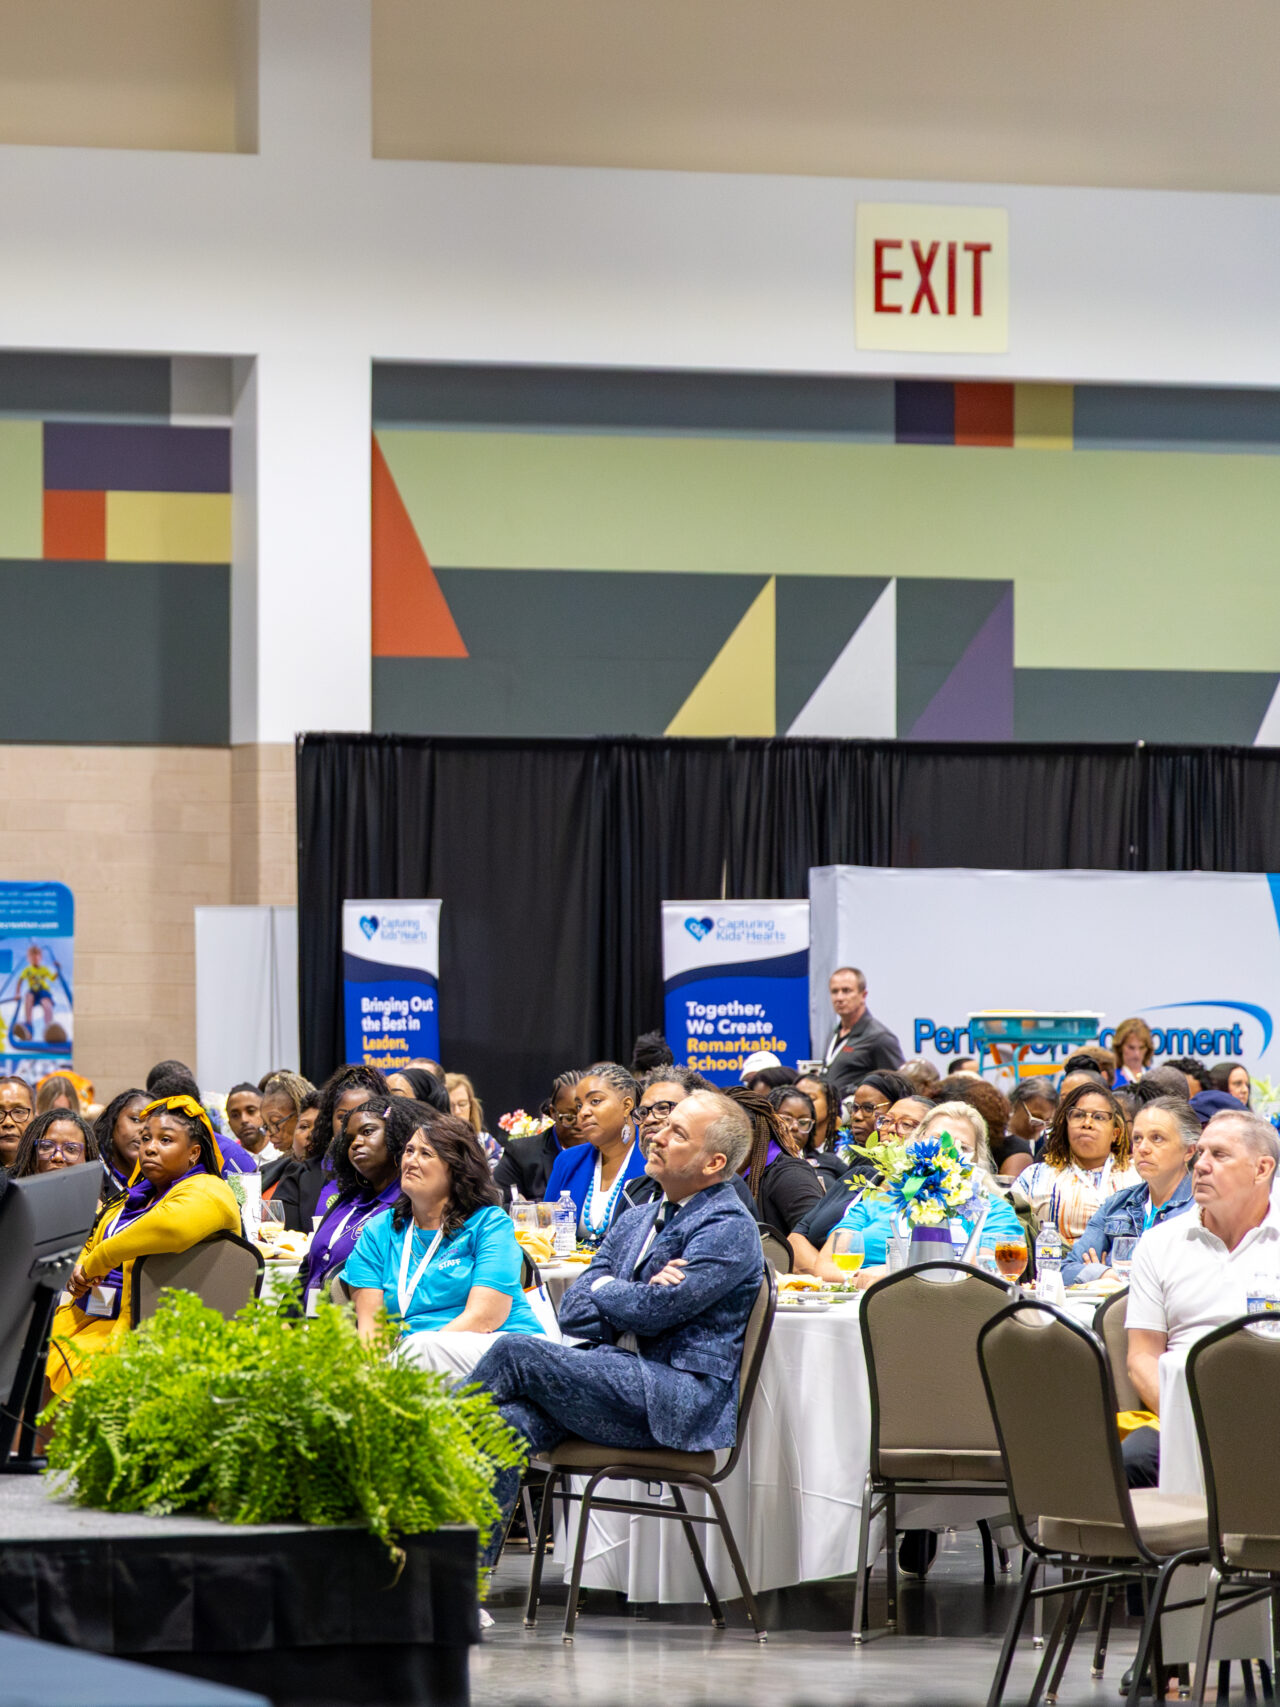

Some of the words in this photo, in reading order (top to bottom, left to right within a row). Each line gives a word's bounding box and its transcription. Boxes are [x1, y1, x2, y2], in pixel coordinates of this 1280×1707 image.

[874, 238, 992, 317] EXIT
[716, 917, 775, 931] Capturing
[746, 930, 786, 941] Hearts
[361, 996, 410, 1016] Bringing
[410, 996, 434, 1013] Out
[686, 1000, 766, 1019] Together,
[361, 1015, 381, 1032] the
[381, 1016, 408, 1032] Best
[408, 1015, 421, 1031] in
[686, 1019, 715, 1035] We
[717, 1019, 774, 1035] Create
[362, 1034, 409, 1051] Leaders,
[687, 1036, 788, 1053] Remarkable
[362, 1052, 411, 1070] Teacher
[687, 1055, 744, 1071] School
[438, 1258, 461, 1271] STAFF
